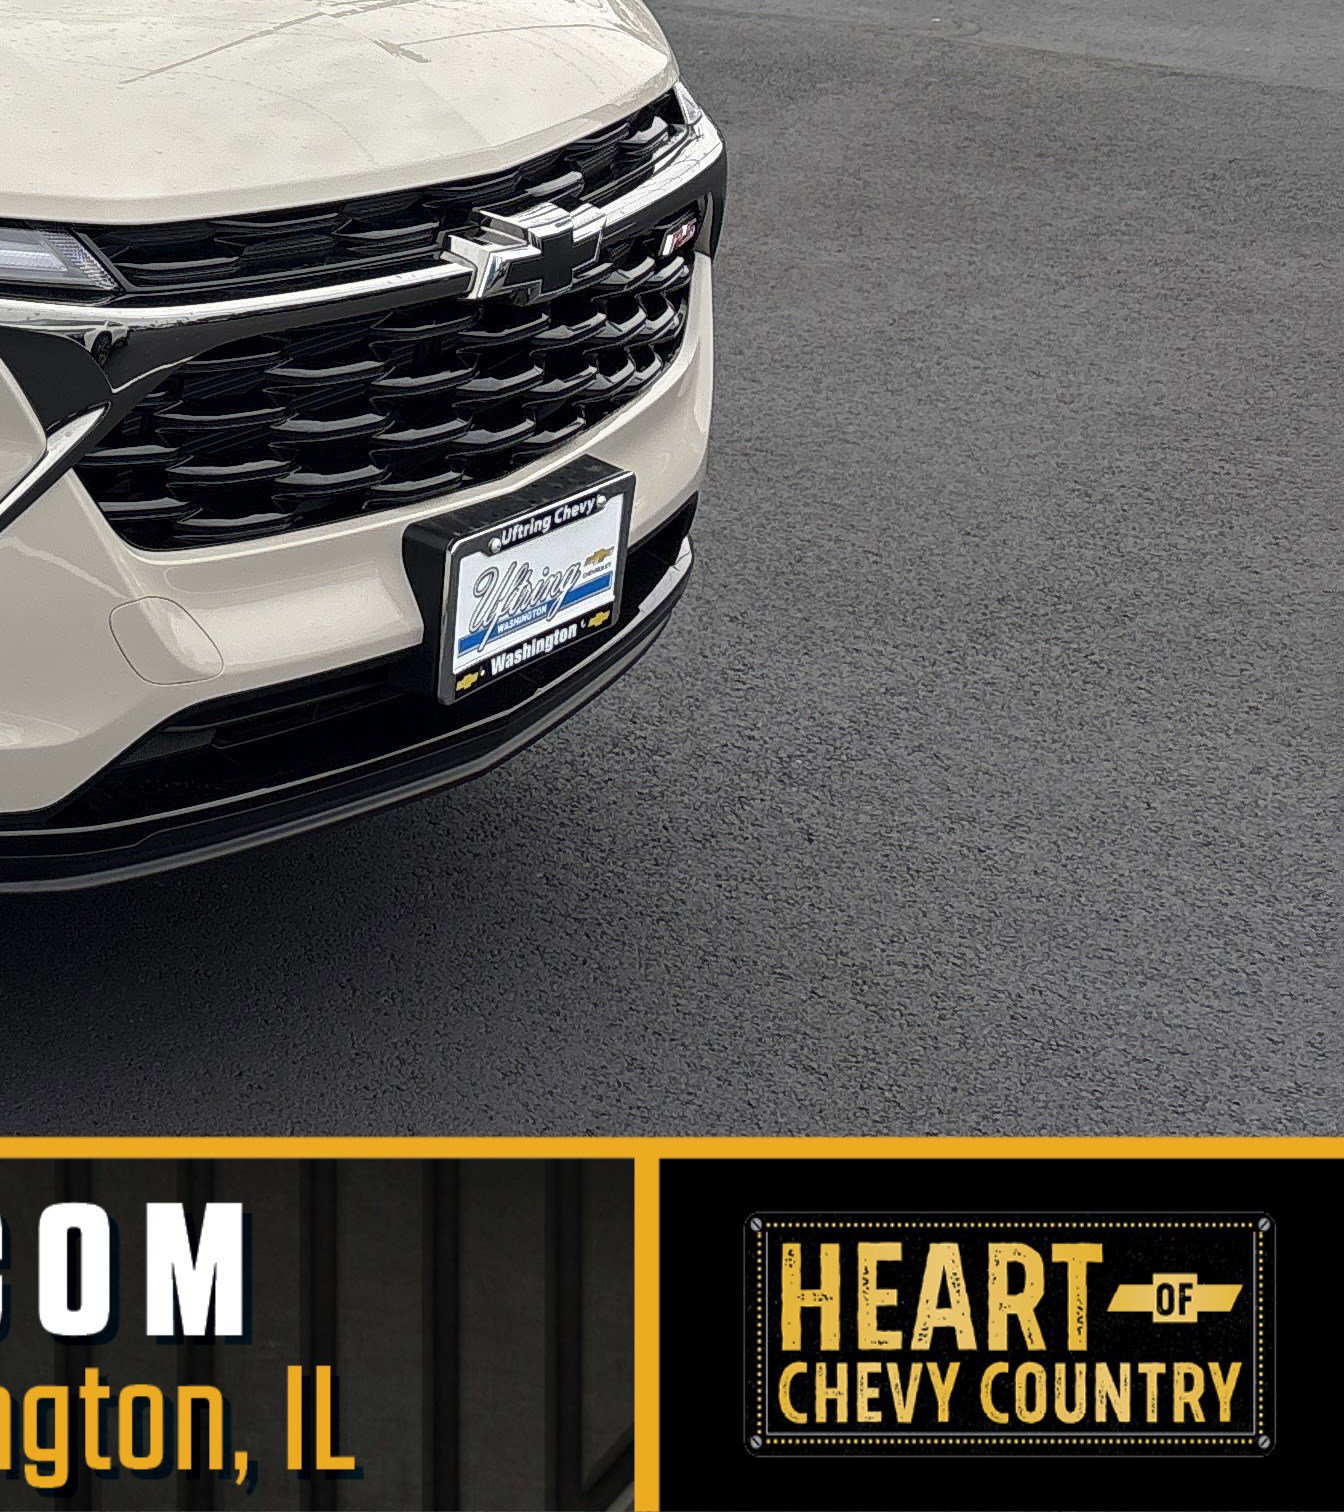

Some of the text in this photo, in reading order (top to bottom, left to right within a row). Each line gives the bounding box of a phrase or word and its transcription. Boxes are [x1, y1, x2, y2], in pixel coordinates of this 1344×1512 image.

[501, 497, 596, 547] Uftring Chevy
[469, 561, 582, 653] Uftring
[496, 604, 548, 634] WASHINGTON
[490, 621, 578, 676] Washington
